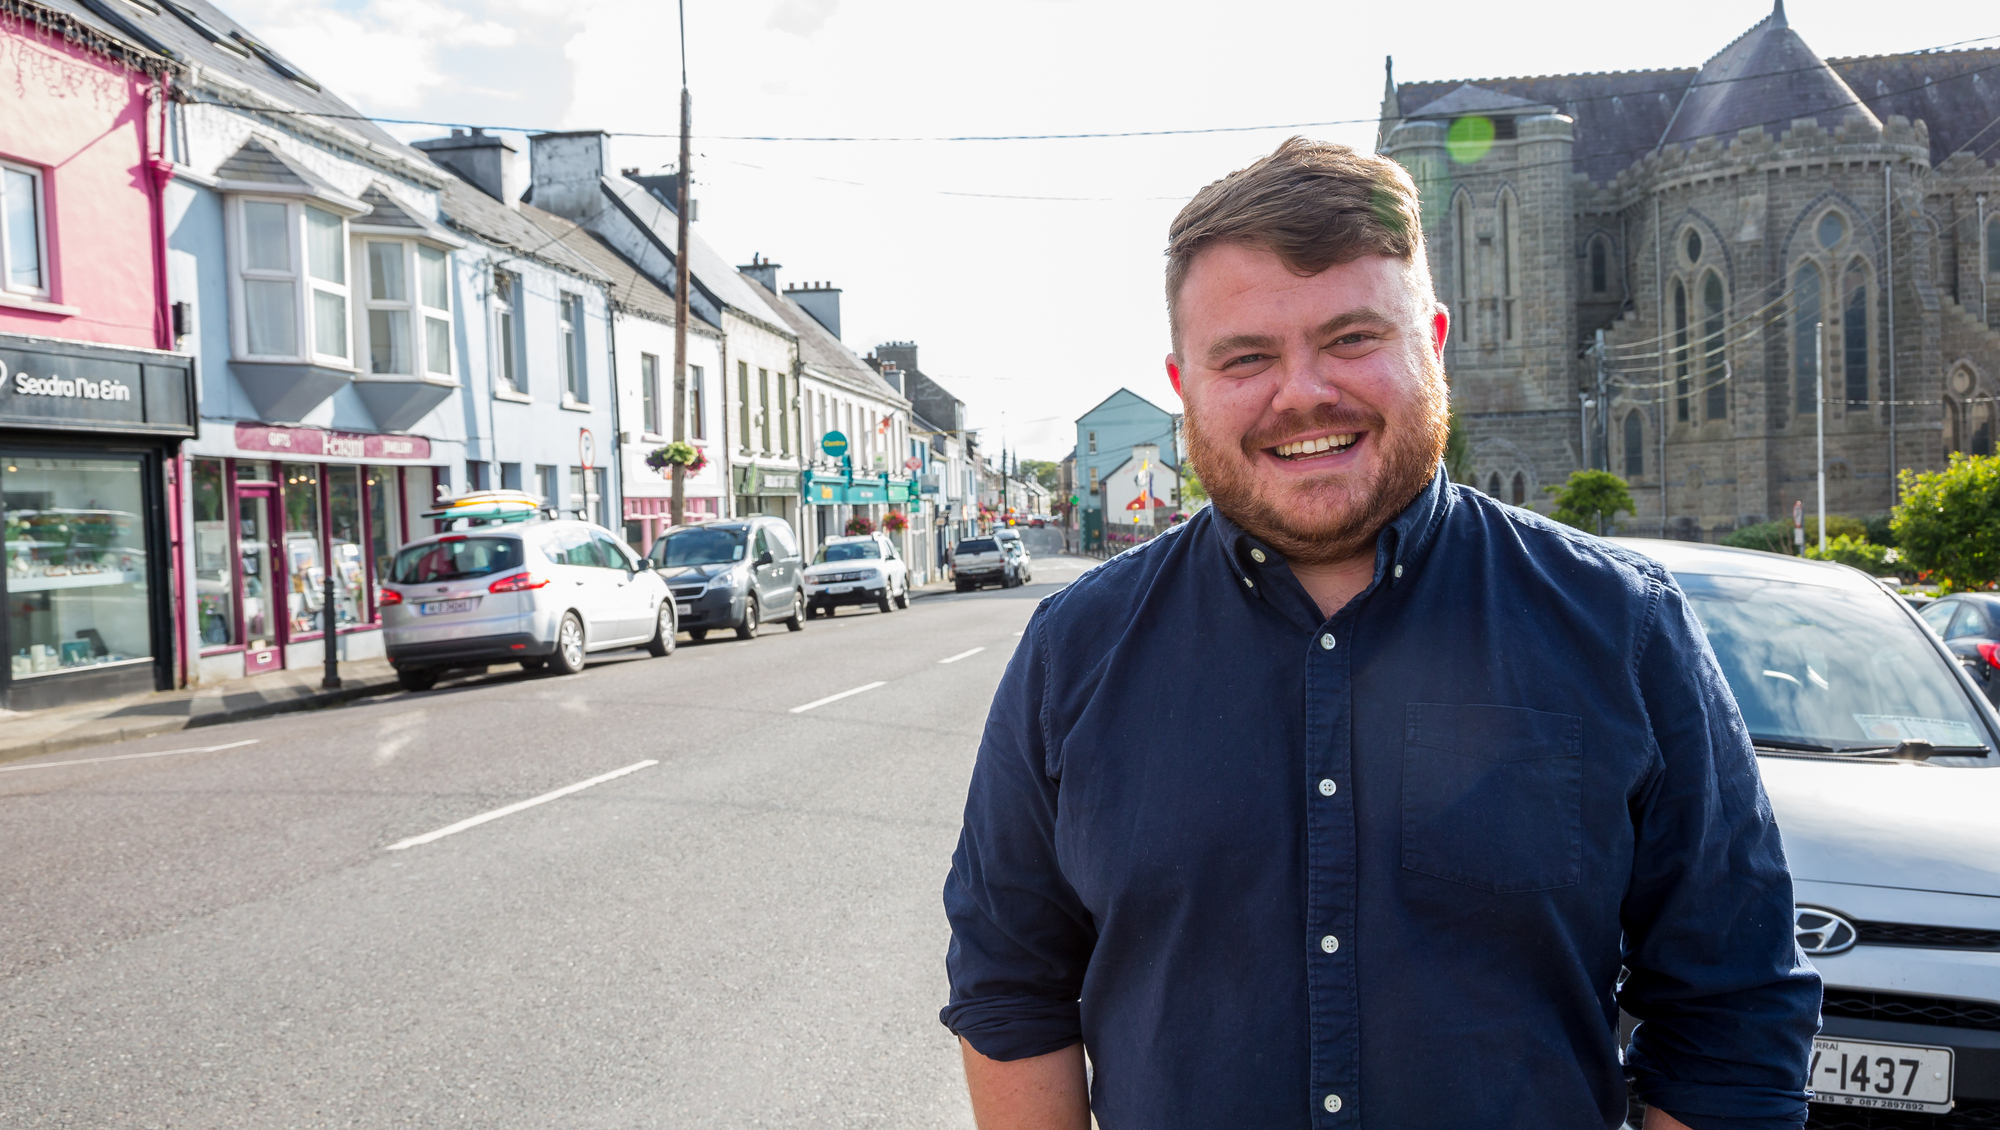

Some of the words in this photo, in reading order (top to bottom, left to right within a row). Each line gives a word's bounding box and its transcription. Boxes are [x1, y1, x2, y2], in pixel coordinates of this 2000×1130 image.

[15, 371, 75, 398] Seodra
[75, 377, 99, 399] Na
[268, 431, 291, 448] GIFTS
[1859, 1099, 1877, 1107] 087
[1881, 1100, 1924, 1110] 2897892
